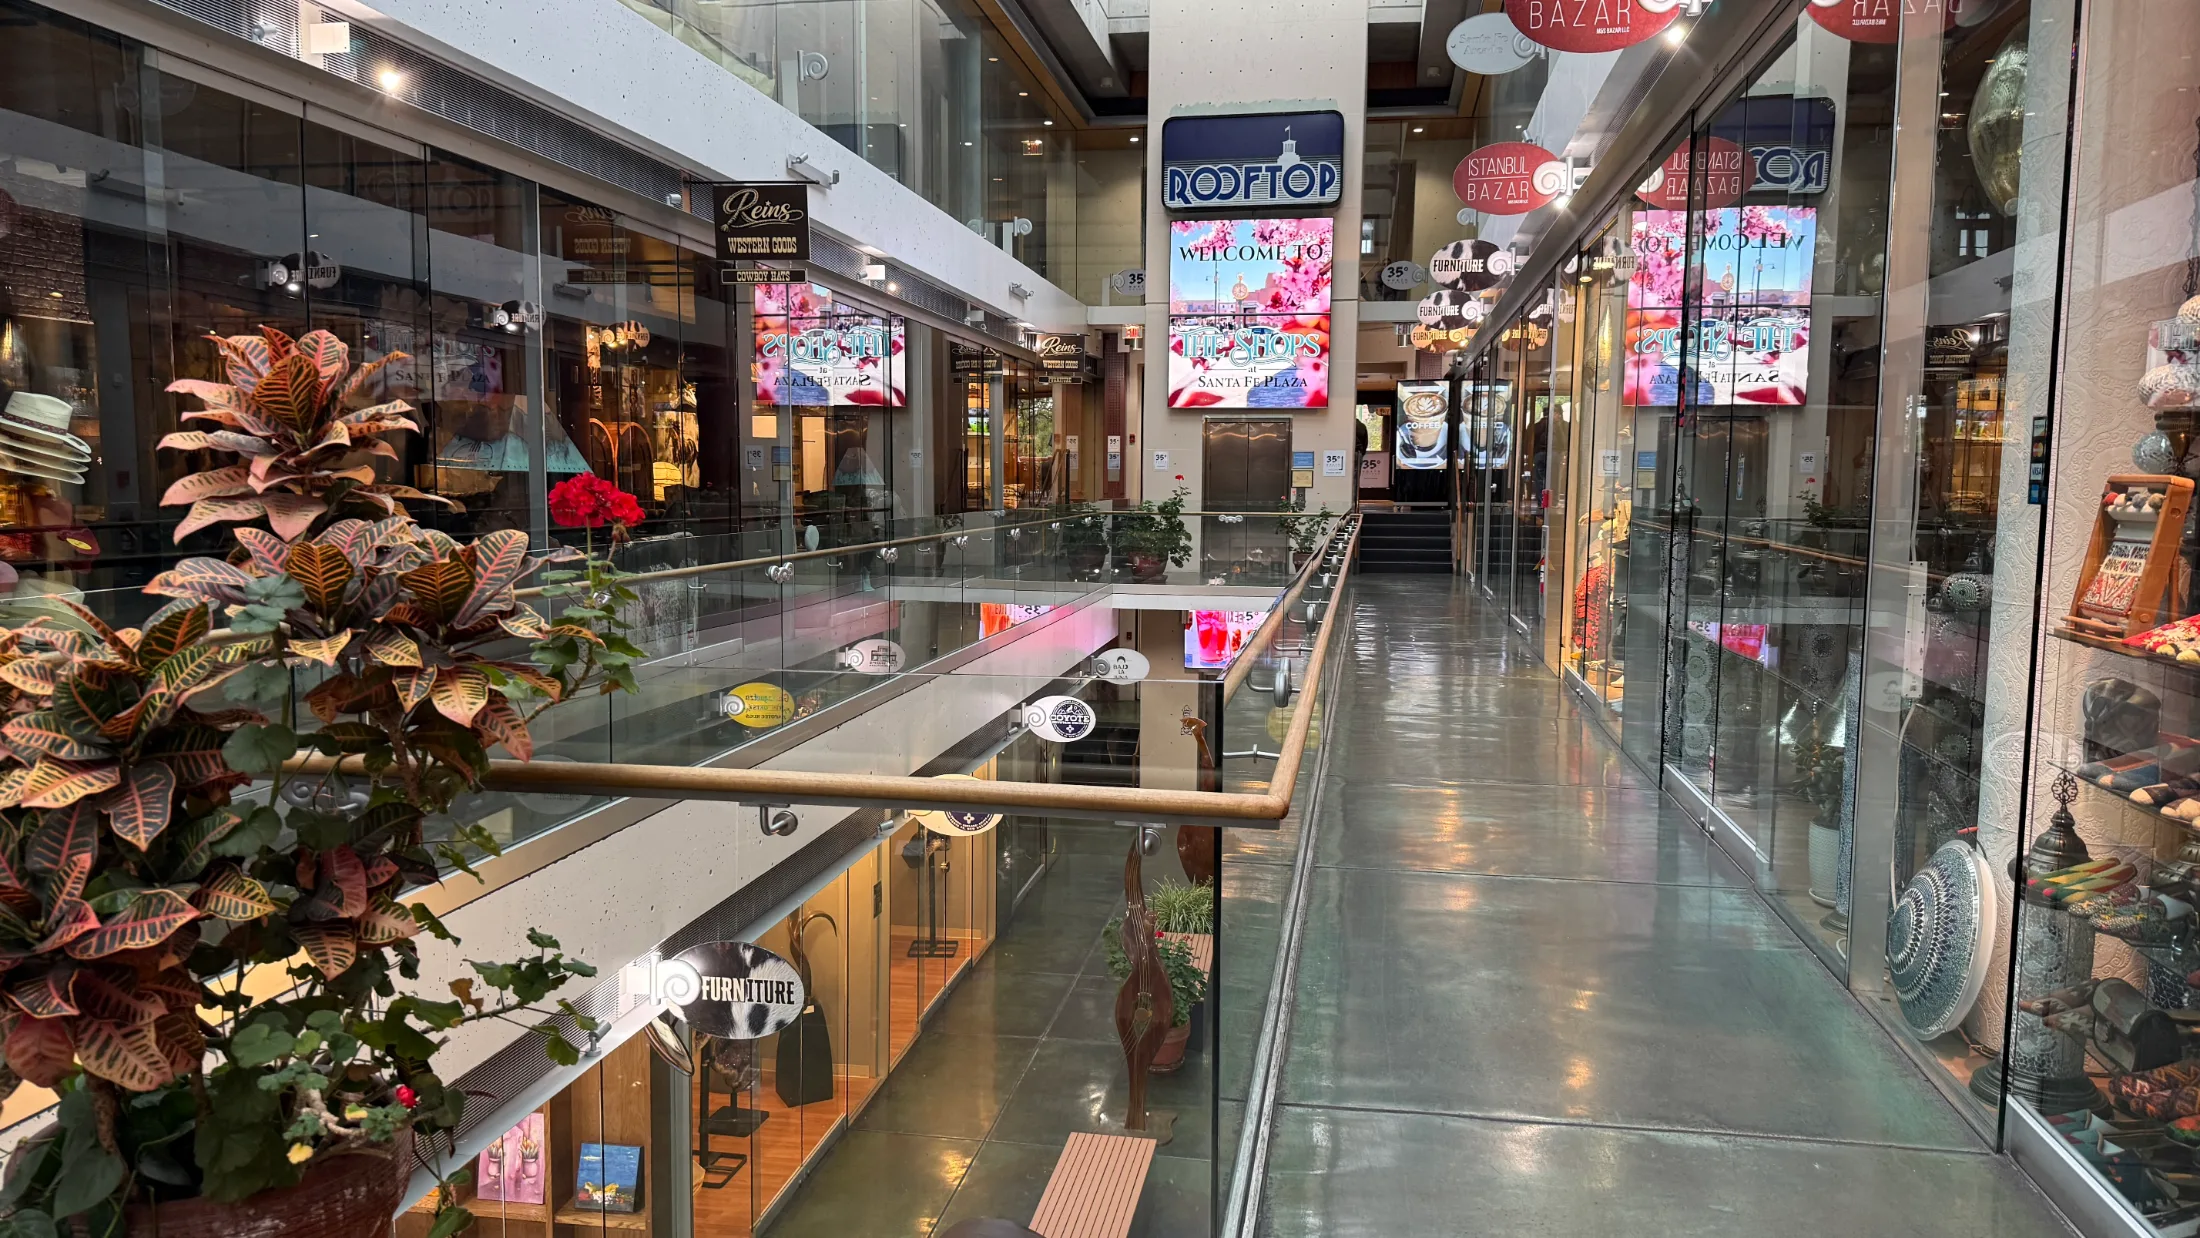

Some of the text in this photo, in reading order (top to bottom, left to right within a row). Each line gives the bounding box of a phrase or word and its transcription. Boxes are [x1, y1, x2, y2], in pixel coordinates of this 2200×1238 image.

[1529, 0, 1630, 29] BAZAR
[1468, 156, 1529, 177] ISTANBUL
[1168, 163, 1336, 204] ROOFTOP
[1467, 180, 1529, 201] BAZAR
[721, 188, 804, 232] Reins
[728, 236, 797, 254] WESTERN GOODS
[1179, 243, 1323, 262] WELCOME TO
[736, 270, 791, 282] COWBOY HATS
[1433, 259, 1484, 273] FURNITURE
[1419, 304, 1459, 317] FURNITURE
[1039, 337, 1082, 357] Reins
[1173, 326, 1321, 367] THE SHOPS
[1198, 376, 1240, 388] SANTA
[1264, 376, 1308, 388] PLAZA
[1050, 714, 1090, 723] COYOTE
[702, 976, 795, 1005] FURNITURE
